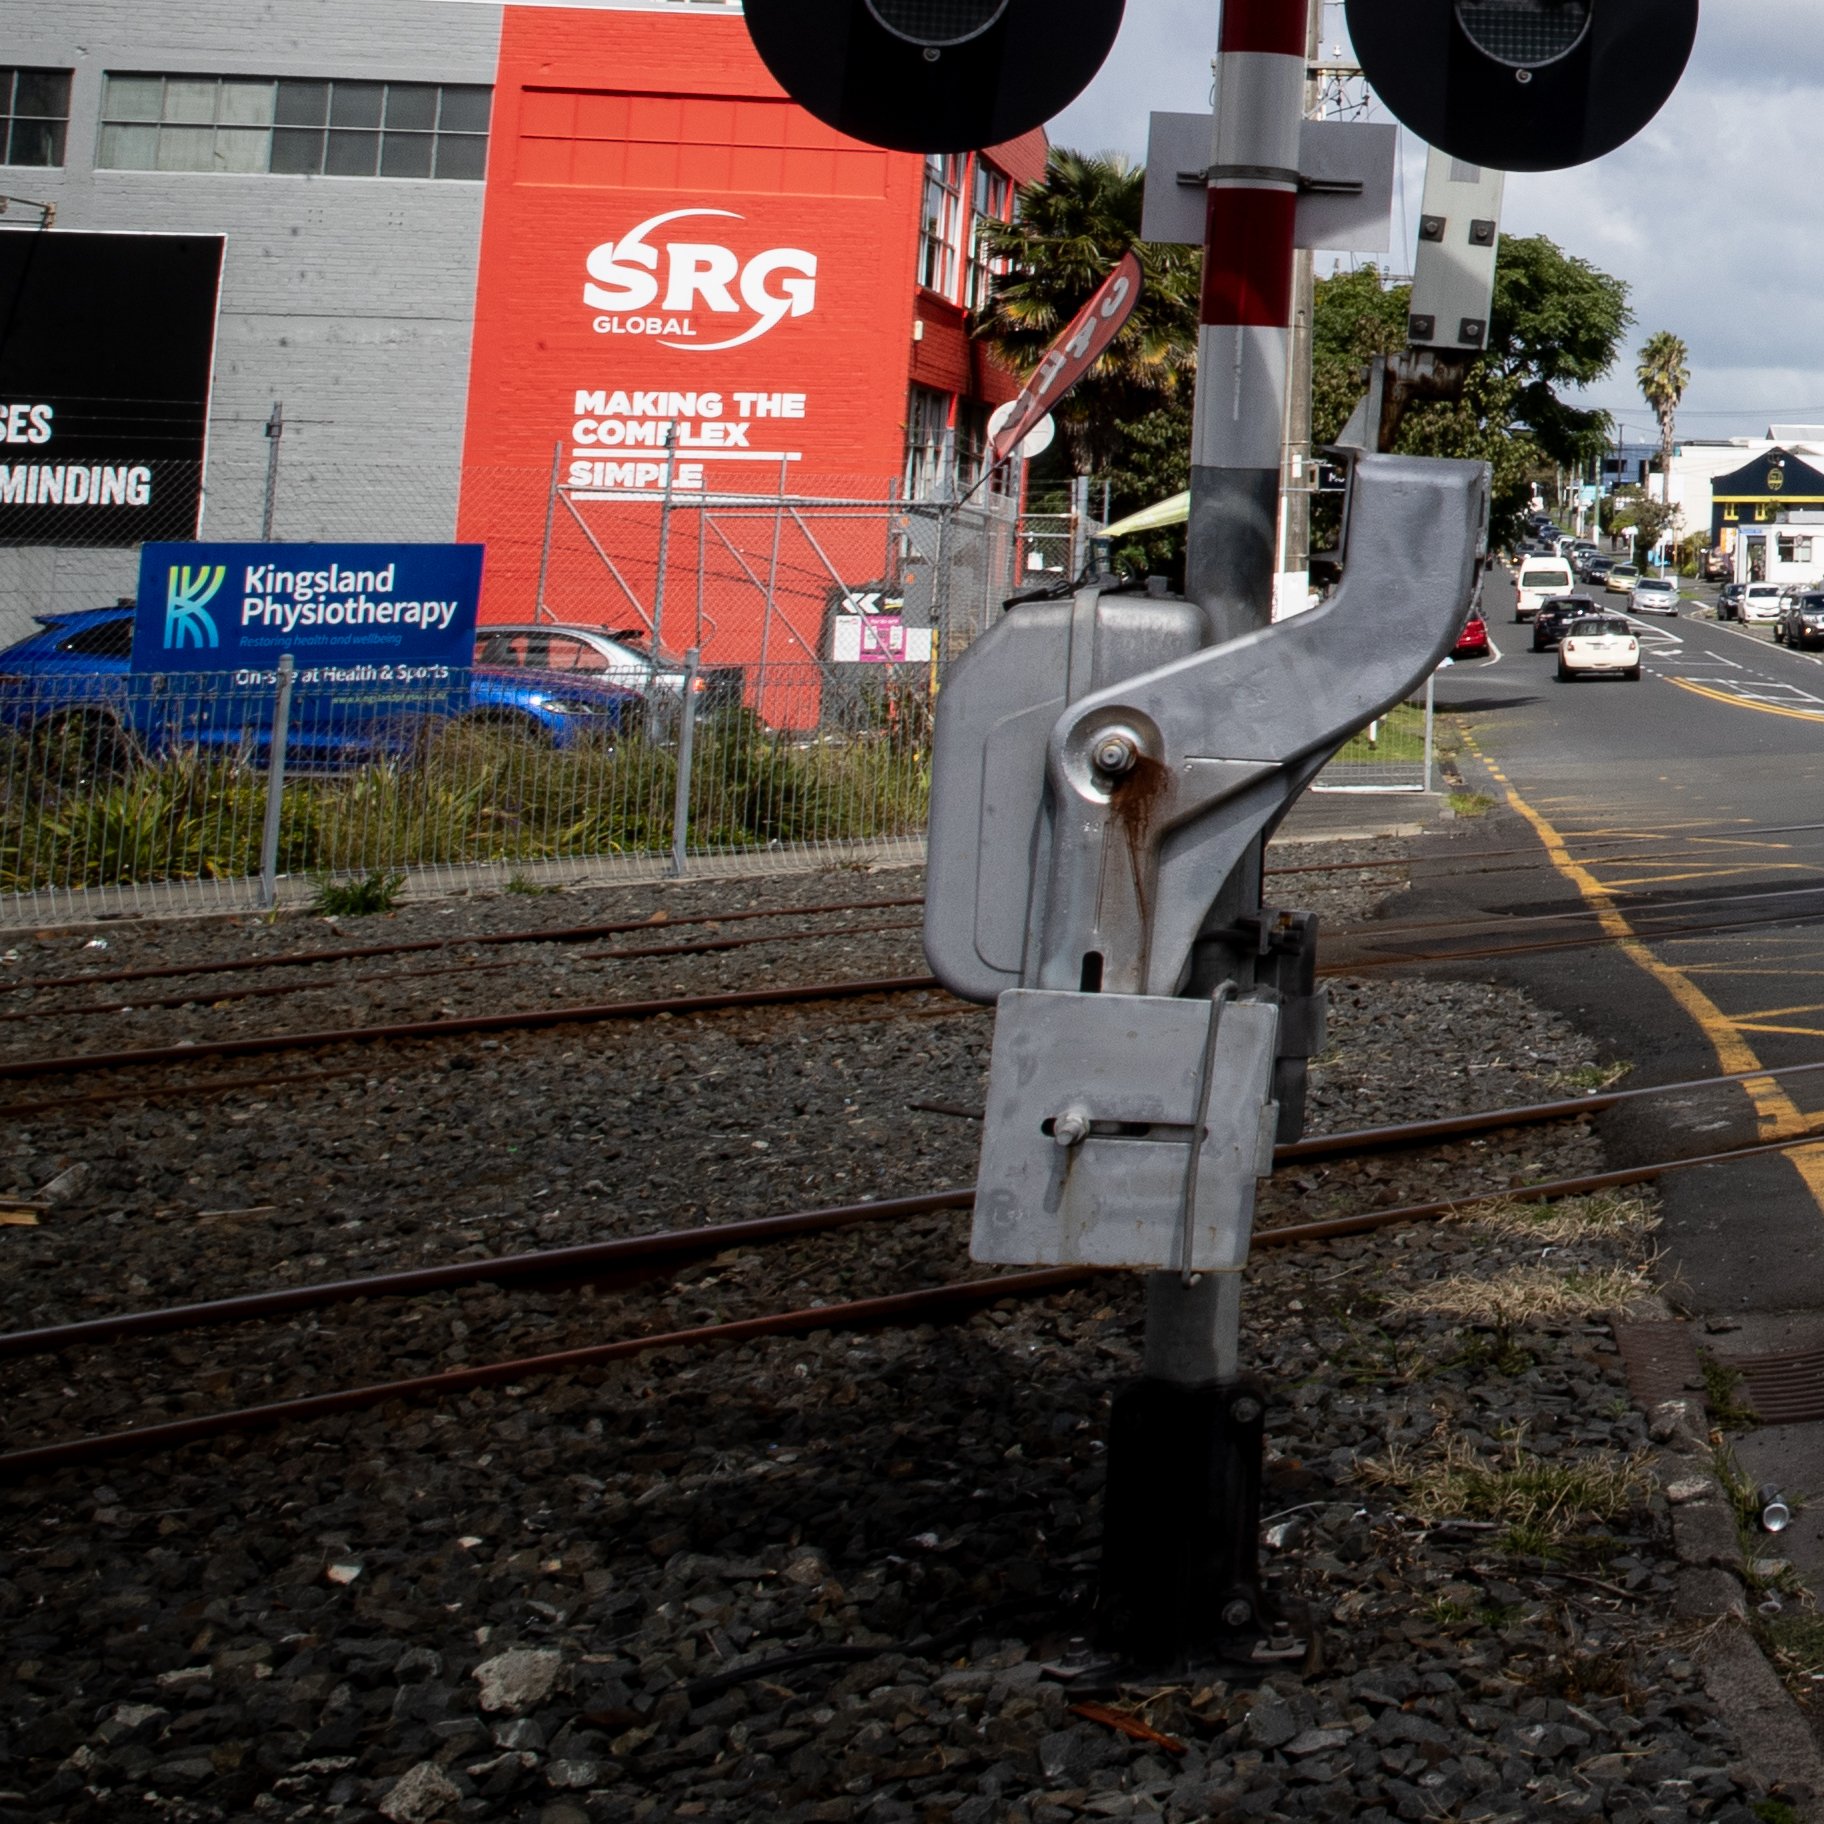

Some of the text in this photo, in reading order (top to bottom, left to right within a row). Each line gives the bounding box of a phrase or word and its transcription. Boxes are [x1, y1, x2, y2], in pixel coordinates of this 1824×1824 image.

[583, 242, 818, 318] SRG
[592, 316, 697, 336] GLOBAL
[574, 389, 806, 418] MAKING THE
[571, 419, 750, 448] COMPLEX
[568, 461, 704, 489] SIMPLE
[244, 563, 395, 600] Kingsland
[241, 596, 457, 633] Physiotherapy
[240, 633, 402, 649] Restoring health and wellbeing
[301, 667, 320, 683] at
[323, 664, 377, 683] Health
[381, 664, 393, 680] &
